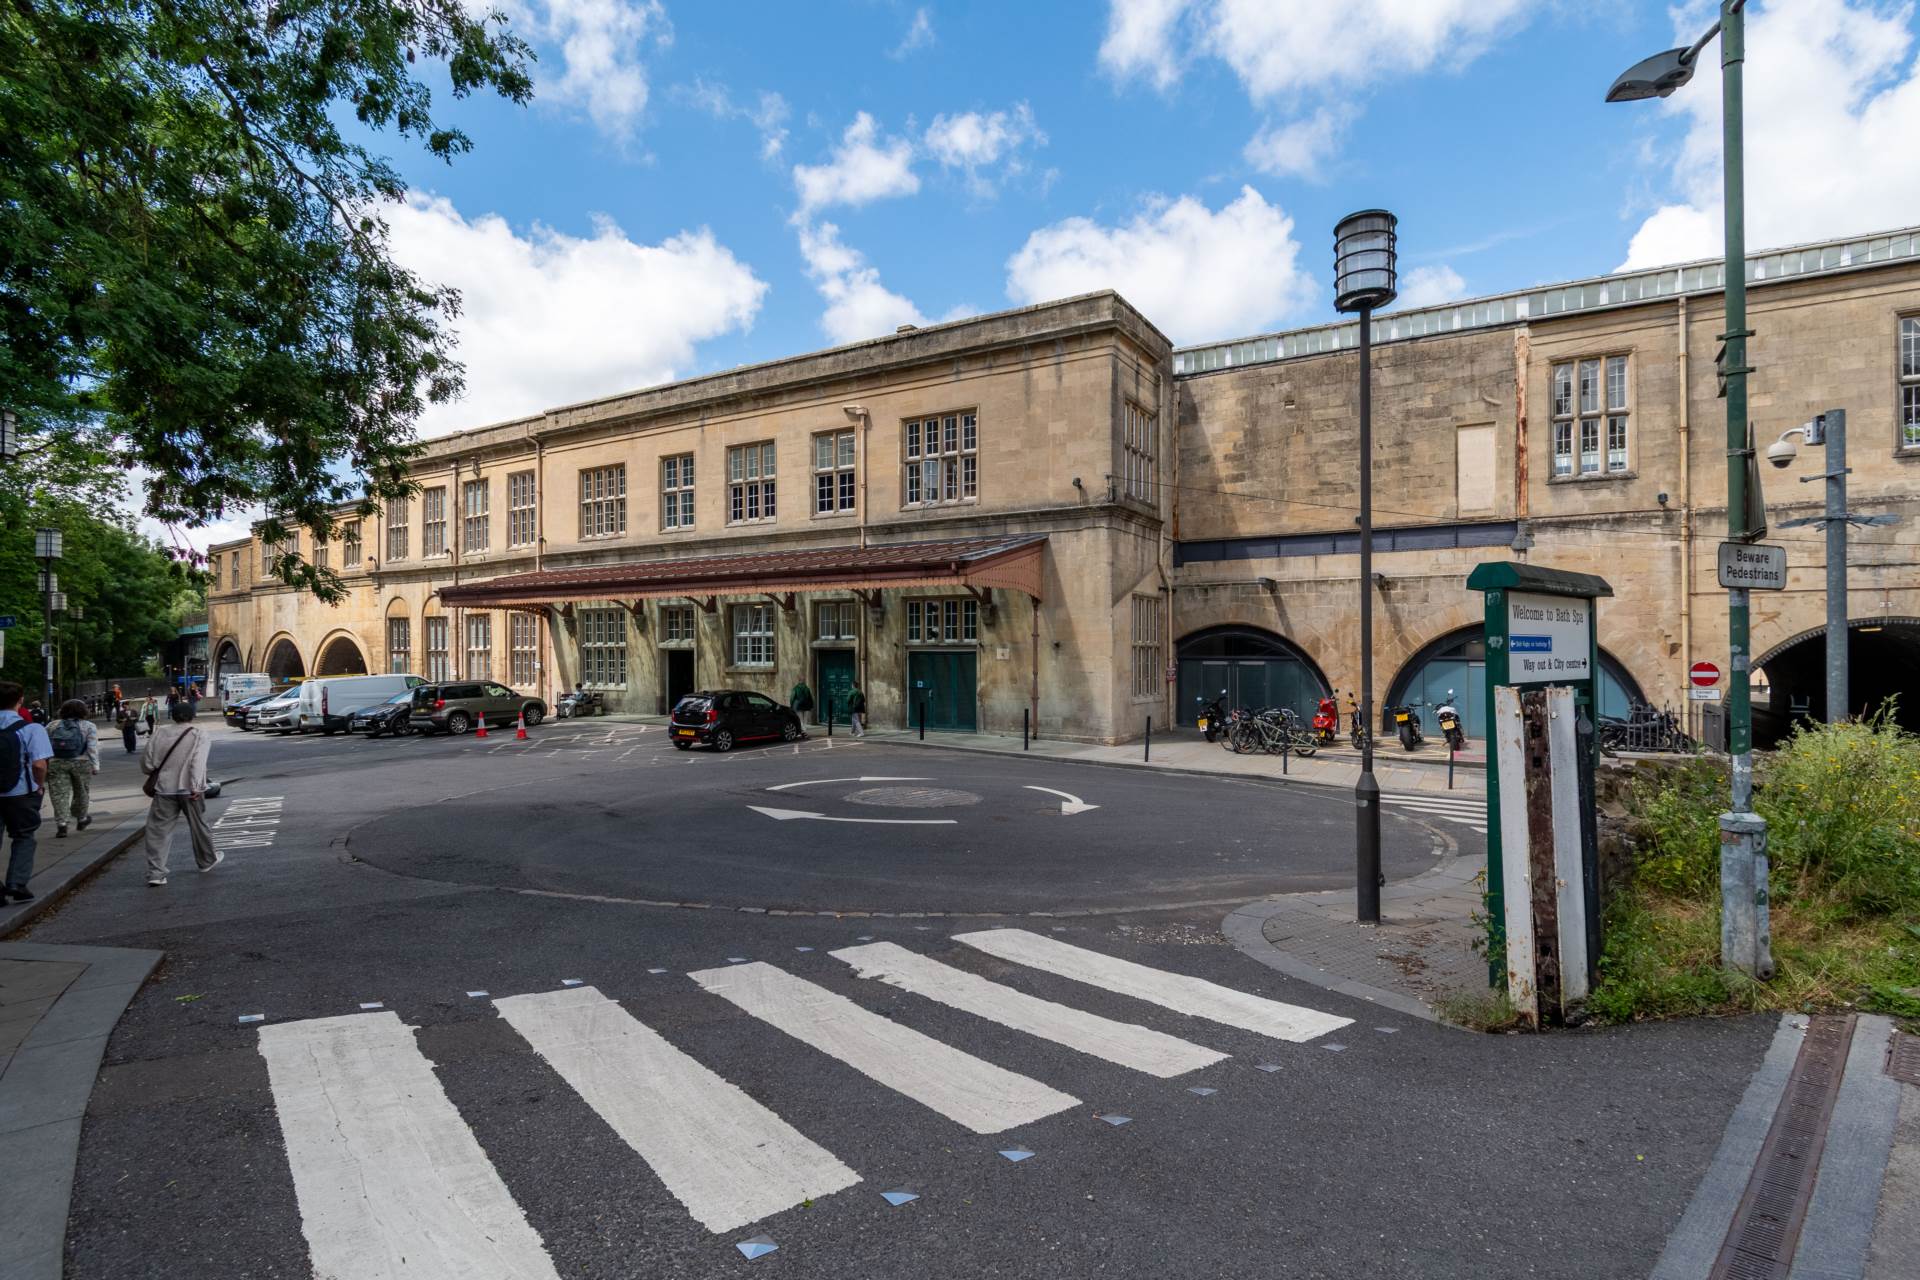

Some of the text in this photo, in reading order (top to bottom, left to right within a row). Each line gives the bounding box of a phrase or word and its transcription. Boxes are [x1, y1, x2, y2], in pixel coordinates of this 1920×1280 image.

[1736, 550, 1770, 564] Beware
[1726, 566, 1779, 581] Pedestrians
[1512, 604, 1584, 626] Welcome to Bath Spa
[1524, 658, 1581, 672] Way out & City centre
